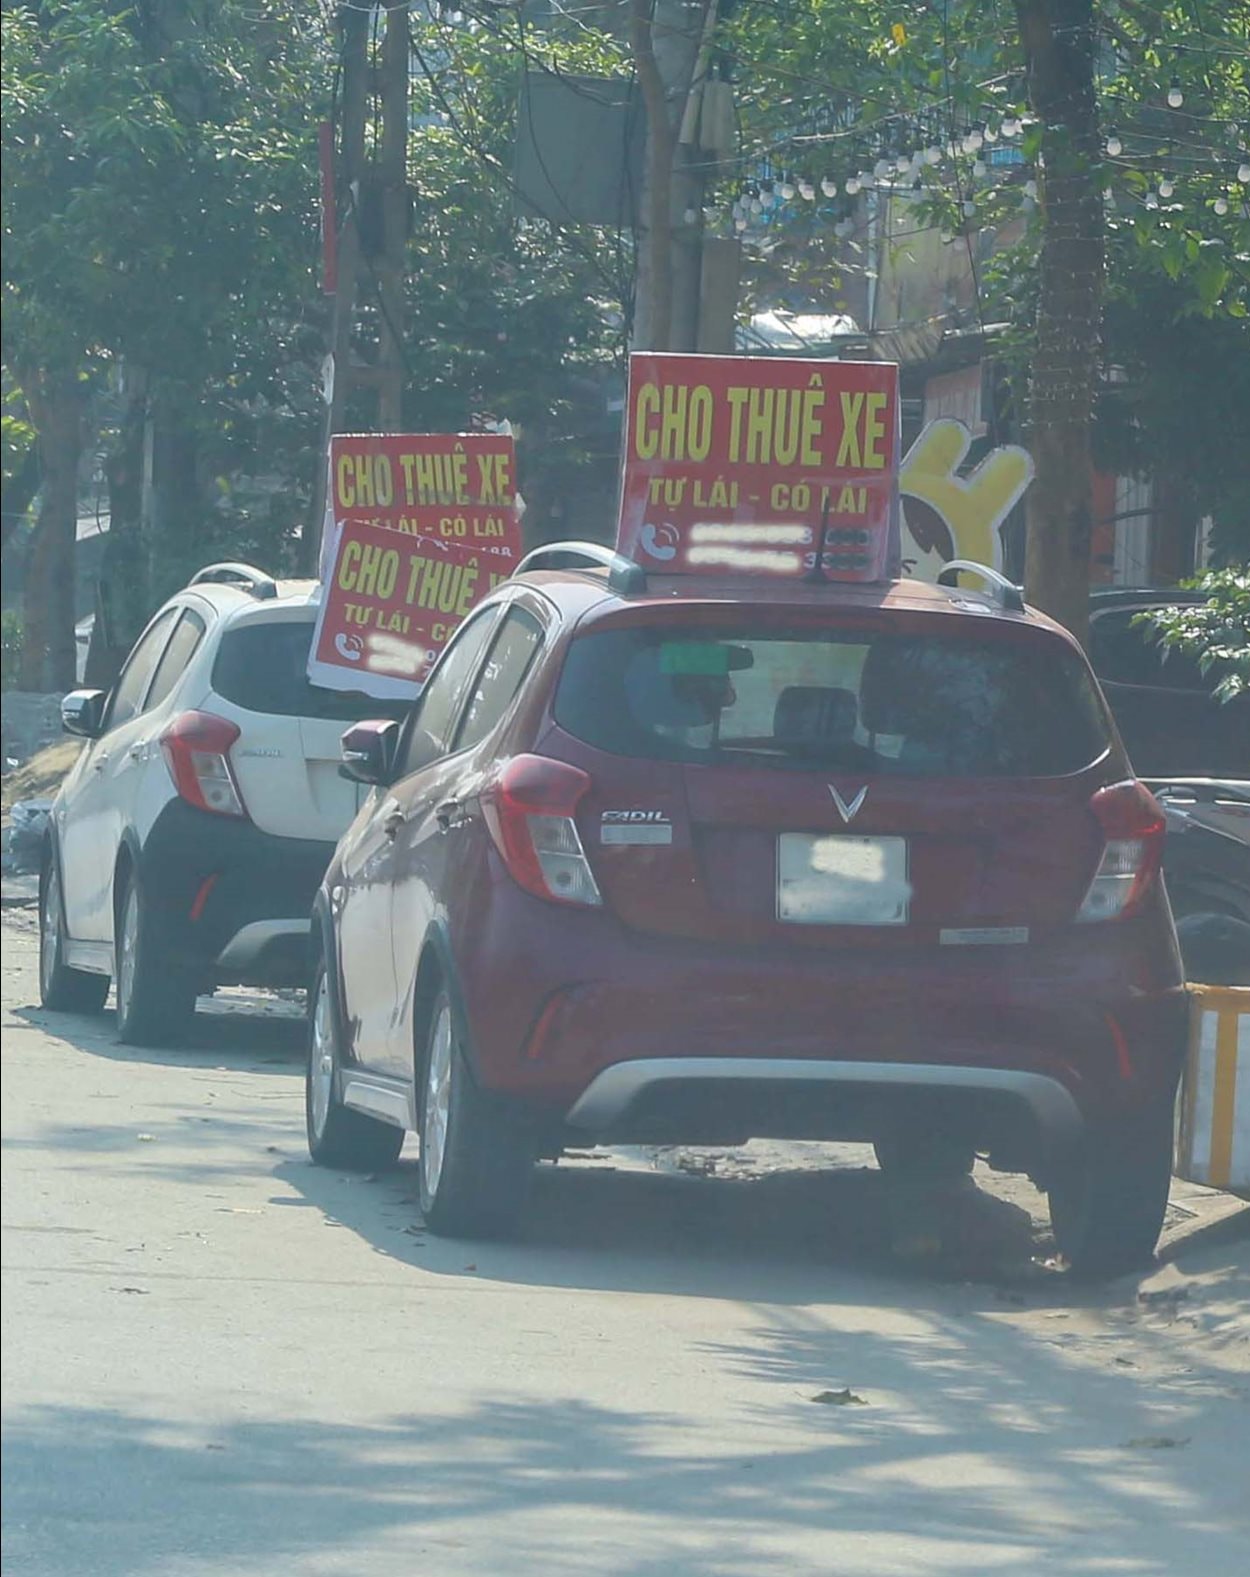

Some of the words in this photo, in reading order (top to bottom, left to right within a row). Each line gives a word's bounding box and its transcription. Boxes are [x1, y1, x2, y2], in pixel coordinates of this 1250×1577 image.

[634, 382, 714, 462] CHO
[727, 373, 825, 467] THUÊ
[836, 390, 888, 470] XE
[337, 454, 394, 508] CHO
[400, 442, 470, 506] THUÊ
[476, 453, 513, 506] XE
[649, 476, 687, 512] TỰ
[693, 475, 739, 509] LÁI
[770, 477, 811, 513] CÓ
[439, 516, 466, 537] CÓ
[474, 514, 505, 537] LÁI
[338, 541, 400, 600] CHO
[405, 557, 479, 617] THUÊ
[344, 603, 374, 629] TỰ
[376, 608, 411, 634] LÁI
[601, 810, 670, 821] FADIL
